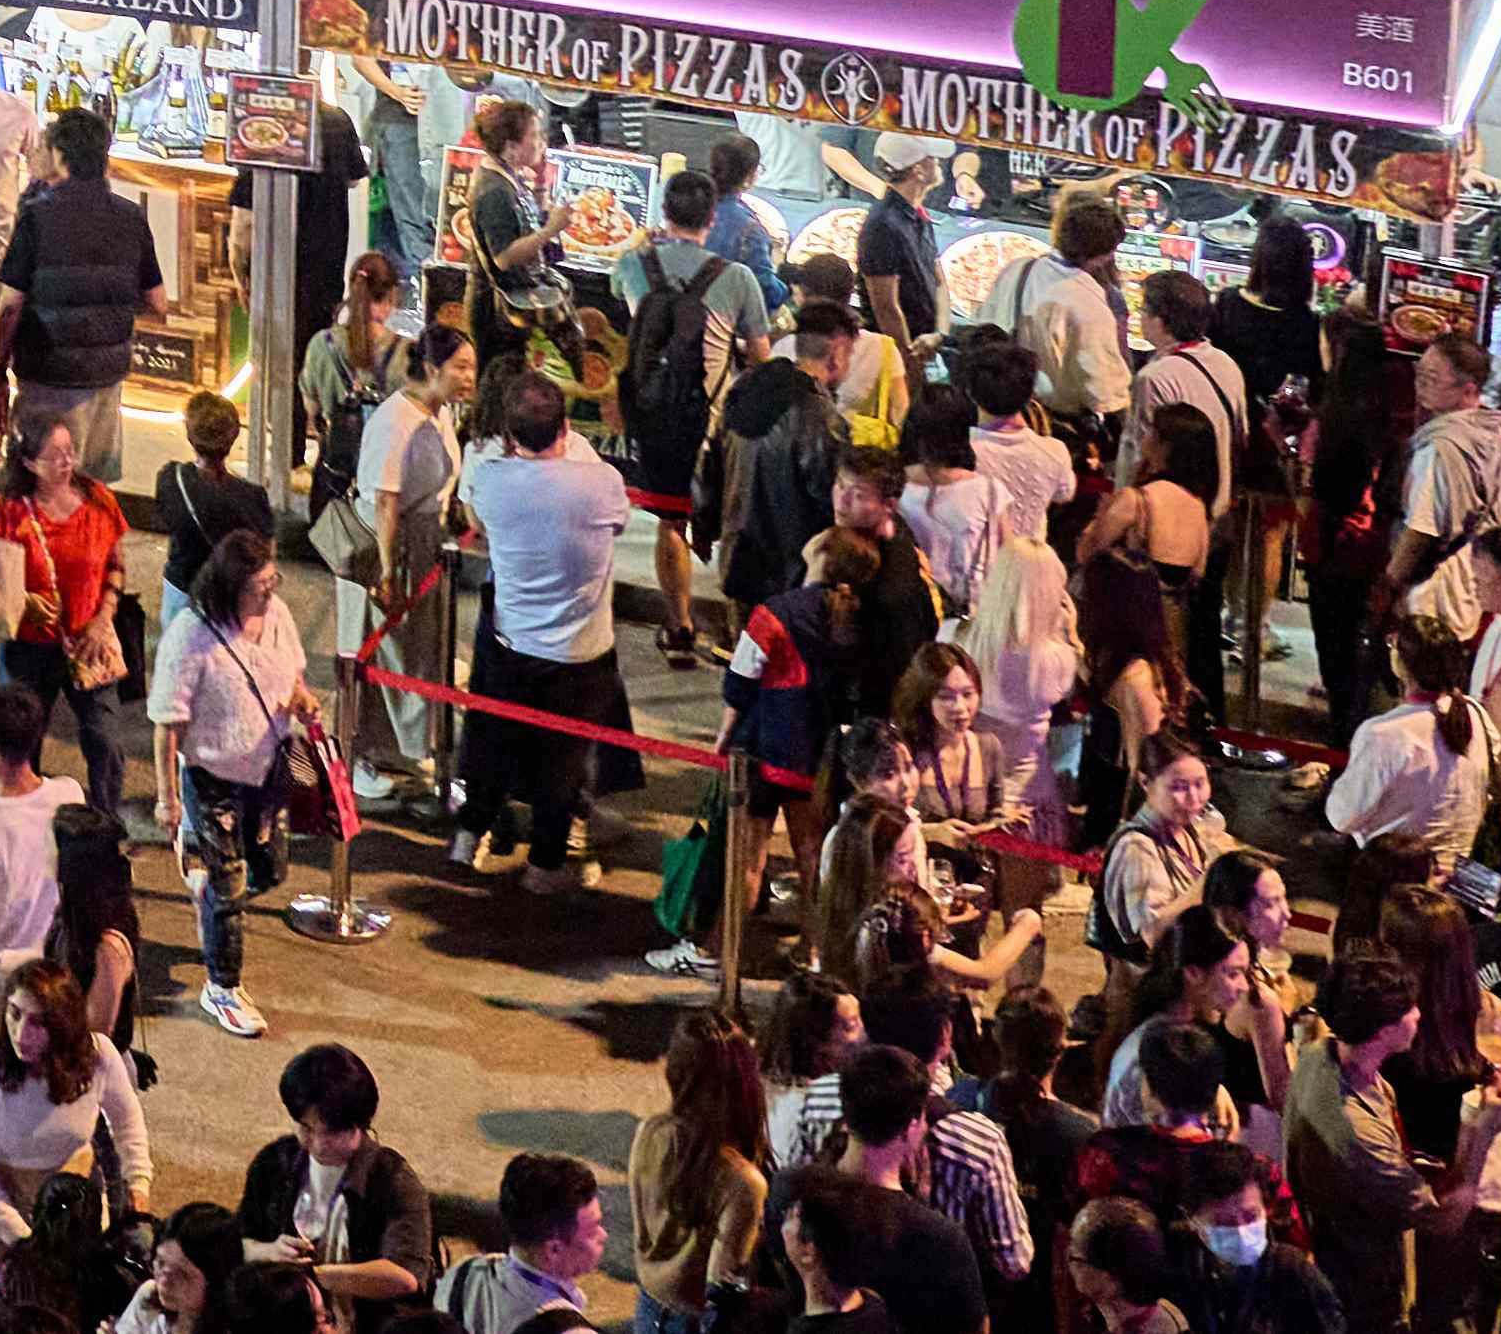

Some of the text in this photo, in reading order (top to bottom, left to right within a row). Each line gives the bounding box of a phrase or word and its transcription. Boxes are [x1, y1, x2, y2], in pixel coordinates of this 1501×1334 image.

[1355, 11, 1415, 43] 美酒
[572, 38, 609, 82] OF
[618, 23, 807, 112] PIZZAS
[1342, 61, 1413, 94] B601
[1104, 113, 1144, 162] OF
[1156, 102, 1359, 197] PIZZAS
